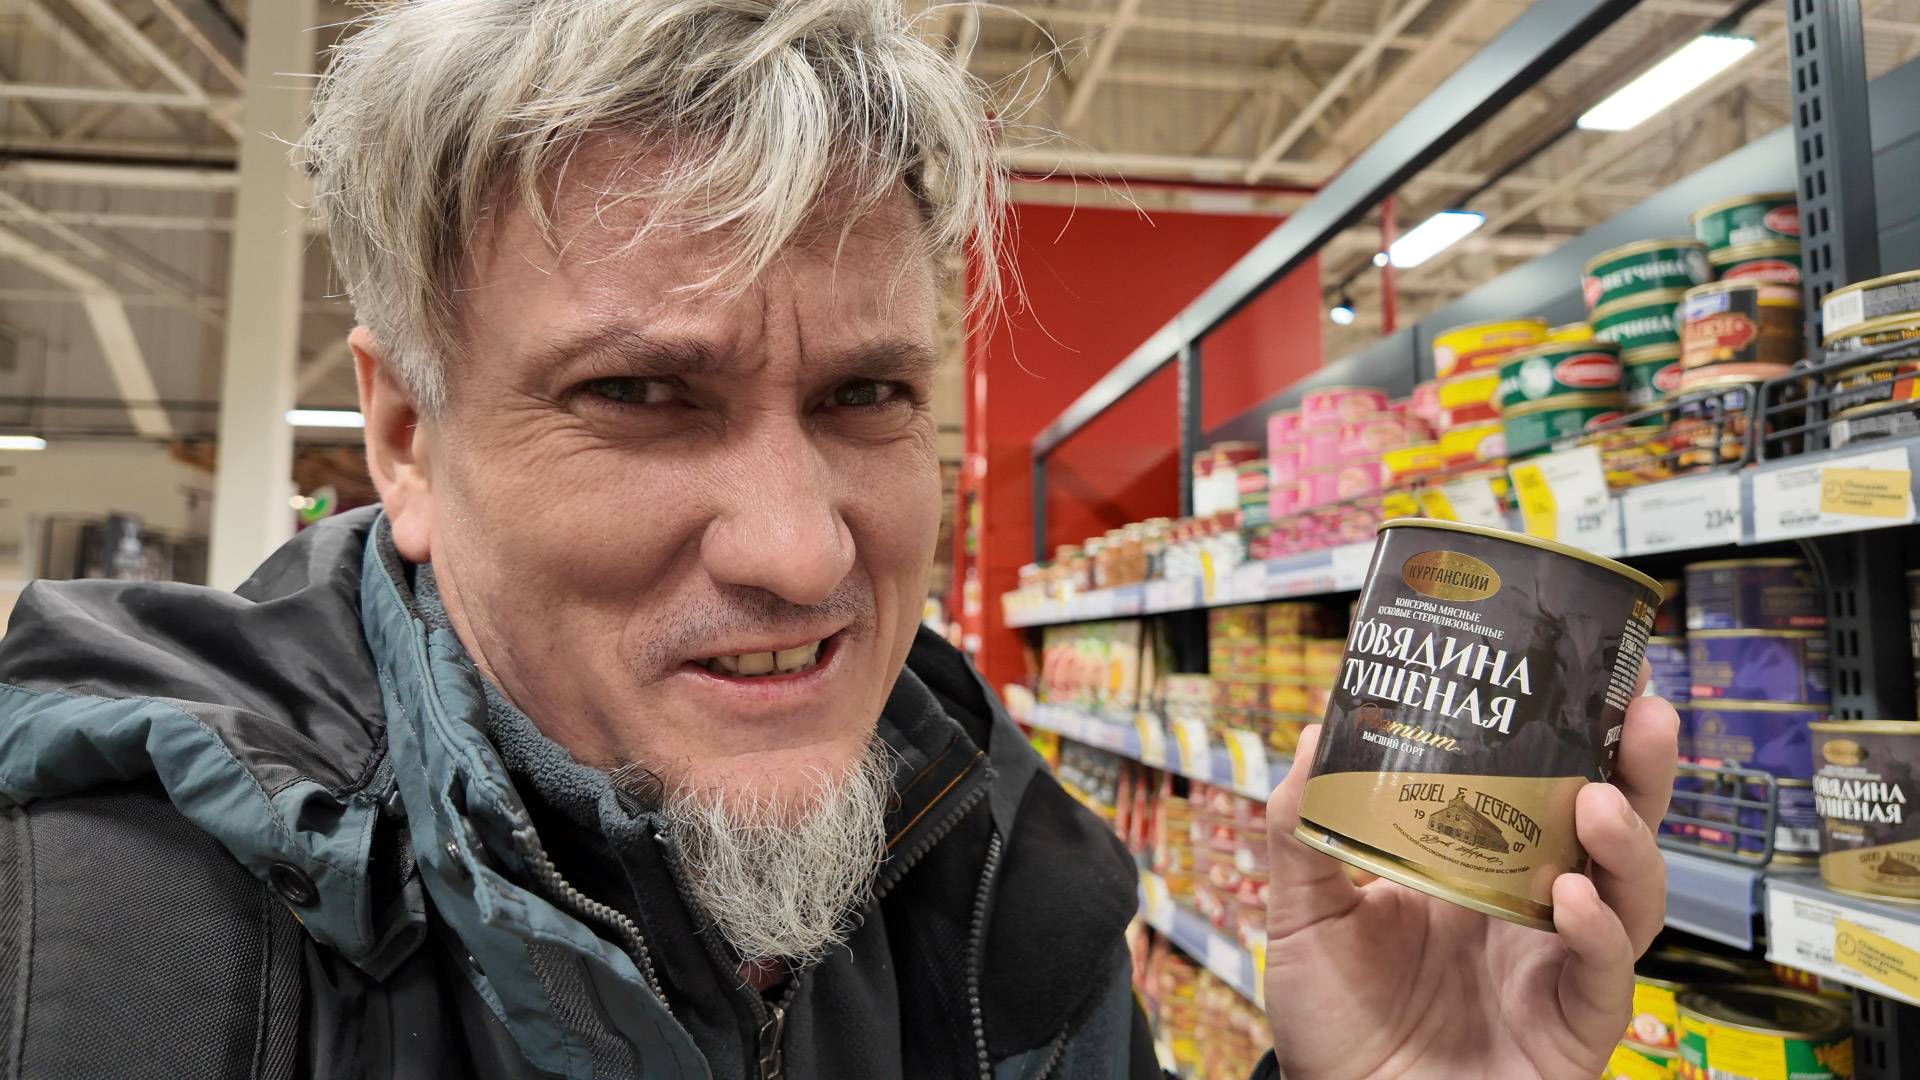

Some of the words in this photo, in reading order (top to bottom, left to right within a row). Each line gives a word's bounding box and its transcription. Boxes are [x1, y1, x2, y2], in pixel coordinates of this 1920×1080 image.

[1408, 564, 1490, 592] КУРГАНСКИЙ
[1378, 605, 1413, 619] КУСКОВЫЕ
[1412, 610, 1505, 640] СТЕРИЛИЗОВАННЫЕ
[1395, 597, 1437, 613] КОНСЕРВЫ
[1439, 605, 1482, 623] МЯСНЫЕ
[1349, 617, 1532, 696] ГОВЯДИНА
[1342, 658, 1517, 735] ТУШЕНАЯ
[1357, 702, 1461, 752] Pemium
[1362, 730, 1400, 750] ВЫСШИЙ
[1400, 742, 1425, 757] СОРТ
[1398, 783, 1446, 803] BRUEL
[1475, 791, 1542, 848] TEGERSON
[1413, 808, 1426, 820] 19
[1513, 841, 1526, 853] 07
